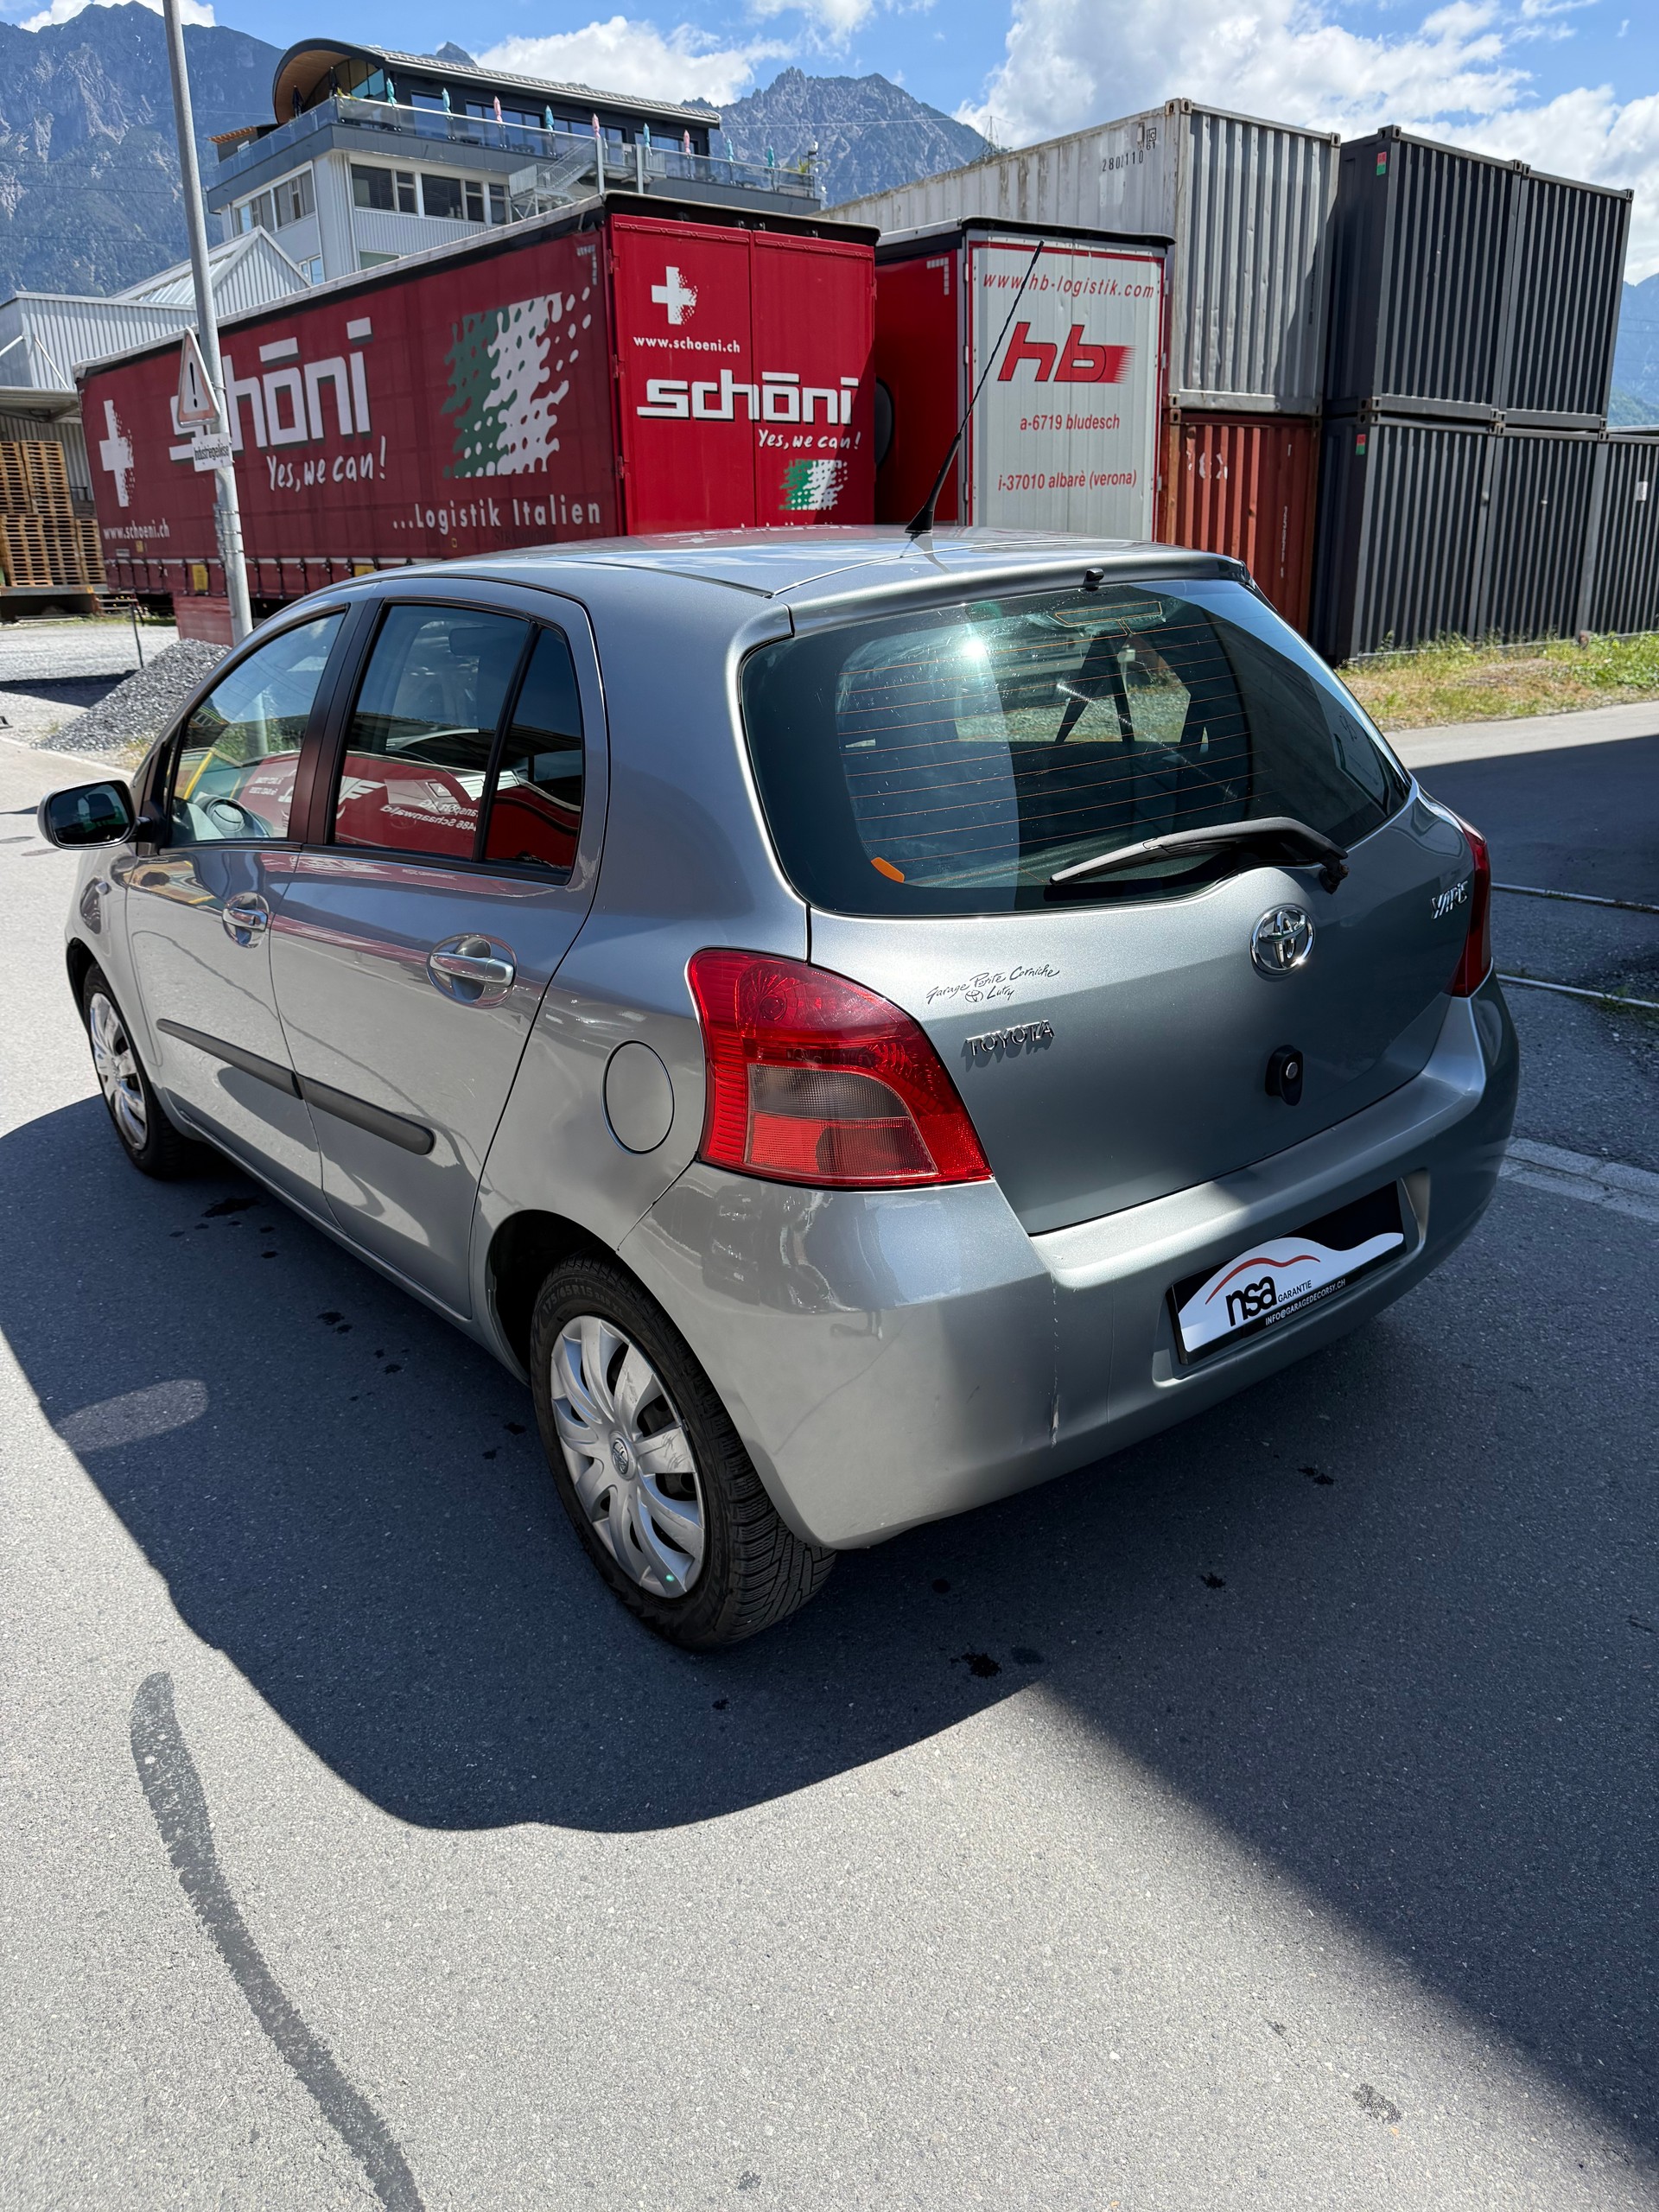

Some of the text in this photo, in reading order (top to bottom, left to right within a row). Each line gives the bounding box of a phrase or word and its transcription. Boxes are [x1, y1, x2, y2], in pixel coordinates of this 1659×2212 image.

[983, 273, 1154, 298] wwwhb-logistik.com
[633, 335, 741, 353] www.schoeni.ch
[997, 321, 1107, 382] hb
[1020, 413, 1120, 430] a-6719 bludesch
[998, 469, 1136, 491] i-37010 albarè (verona)
[512, 494, 601, 526] Italien
[103, 518, 170, 540] www.schoeni.ch
[926, 982, 970, 1004] Garage
[1009, 964, 1060, 981] Corniche
[987, 986, 1015, 1001] Lutry
[964, 1020, 1055, 1056] TOYOTA
[1225, 1276, 1313, 1326] nsa GARANTIE
[1265, 1278, 1346, 1325] INFO@GARAGEDECORSY.CH
